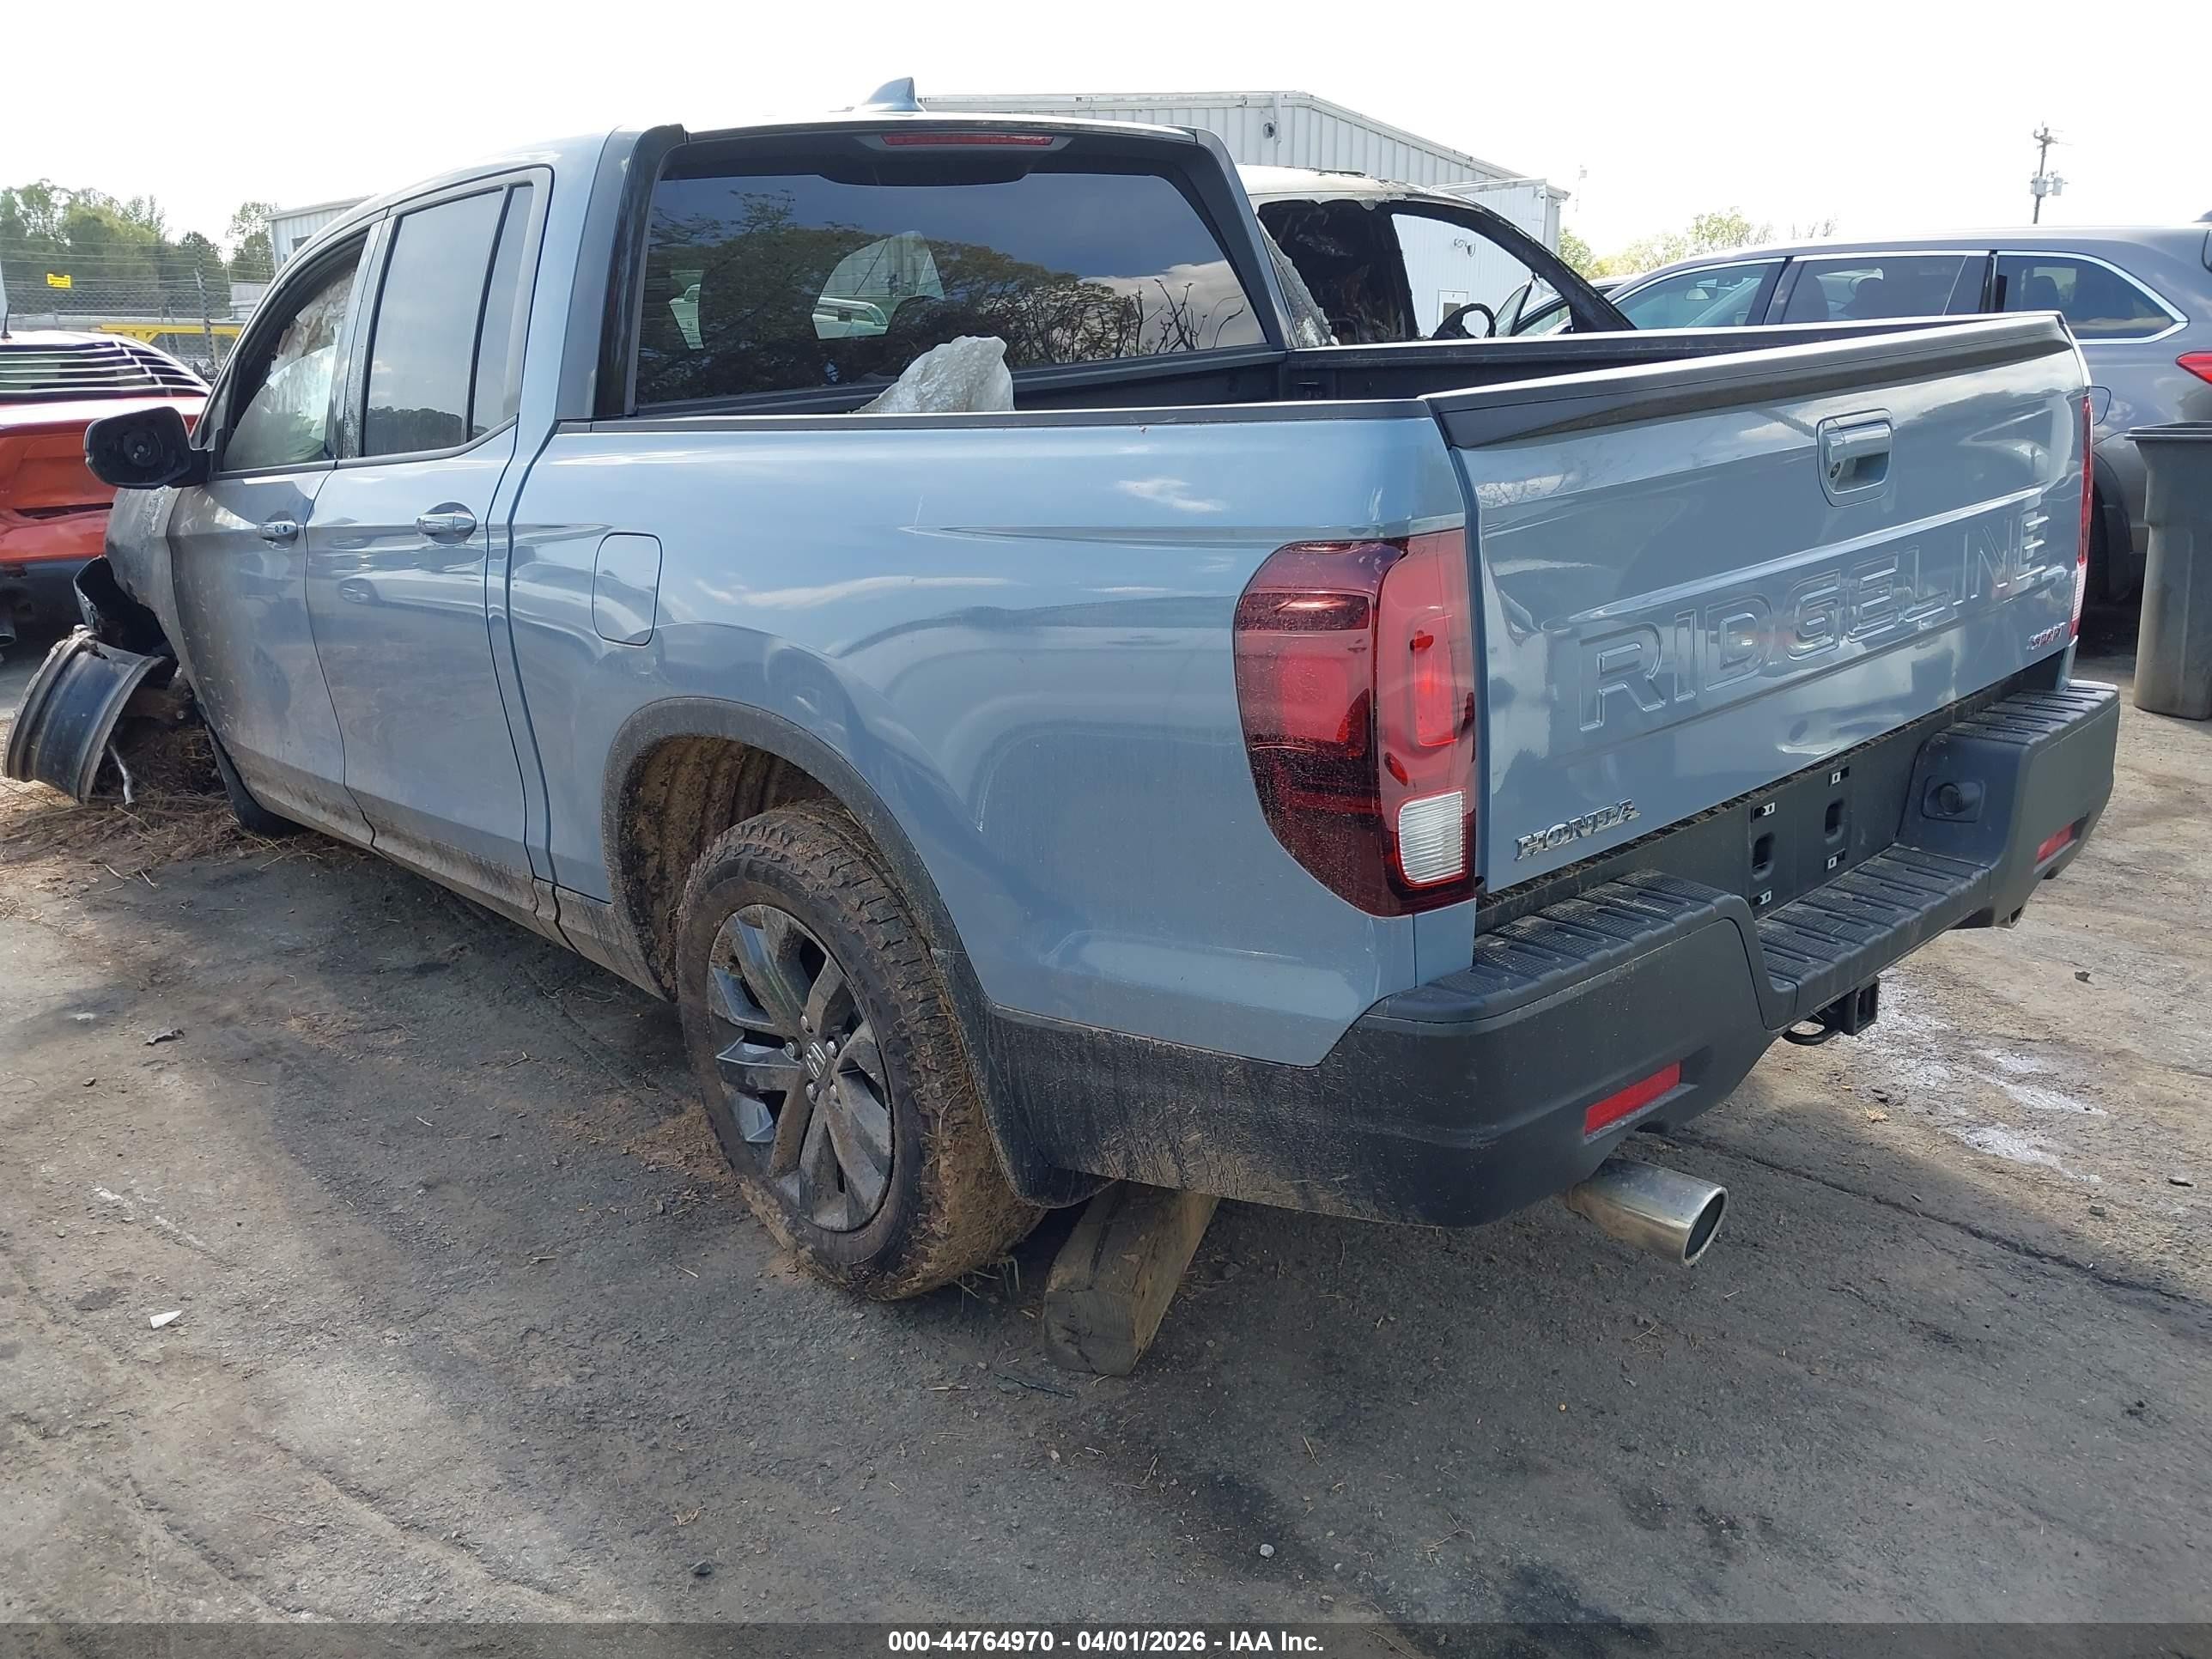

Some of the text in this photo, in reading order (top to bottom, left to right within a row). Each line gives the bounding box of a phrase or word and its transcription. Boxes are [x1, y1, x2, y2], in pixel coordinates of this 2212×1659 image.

[1578, 514, 2050, 732] RIDGELINE
[2027, 621, 2067, 651] SPORT
[1514, 798, 1642, 860] HONDA
